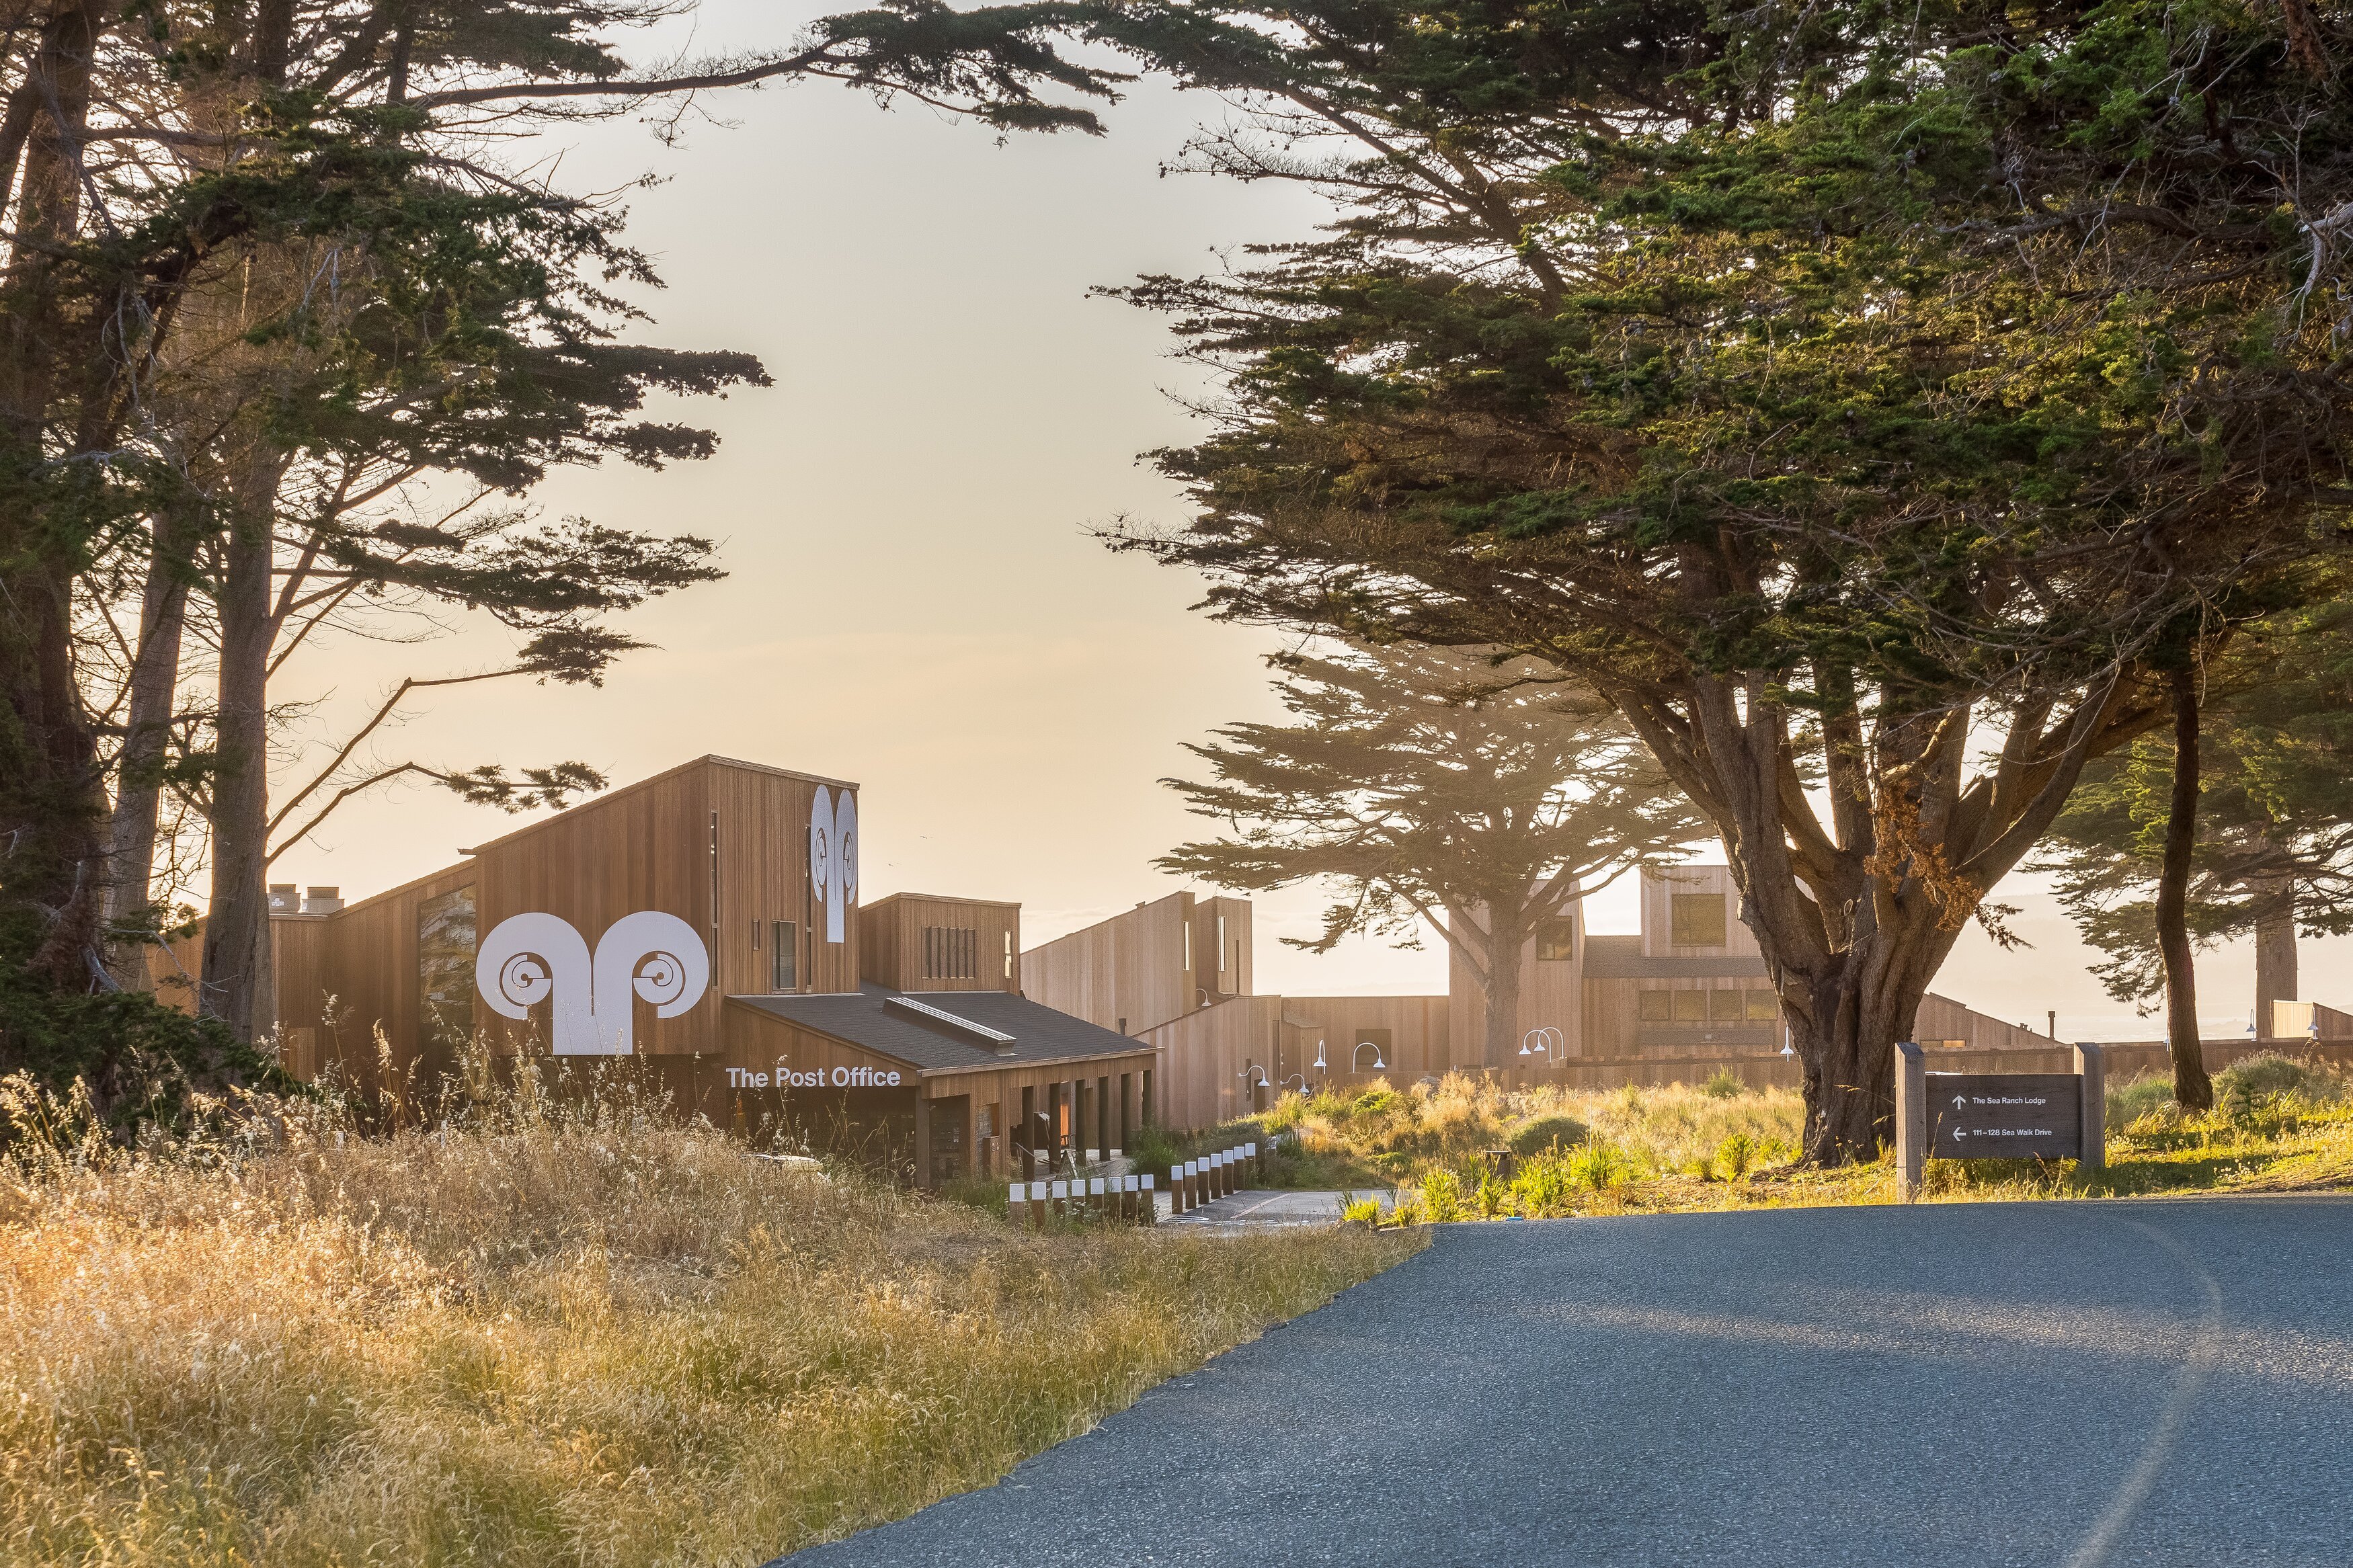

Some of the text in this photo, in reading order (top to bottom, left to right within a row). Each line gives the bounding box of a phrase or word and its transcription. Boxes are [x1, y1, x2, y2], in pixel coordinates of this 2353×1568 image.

[725, 1066, 901, 1087] The Post Office
[2024, 1097, 2046, 1105] Lodge
